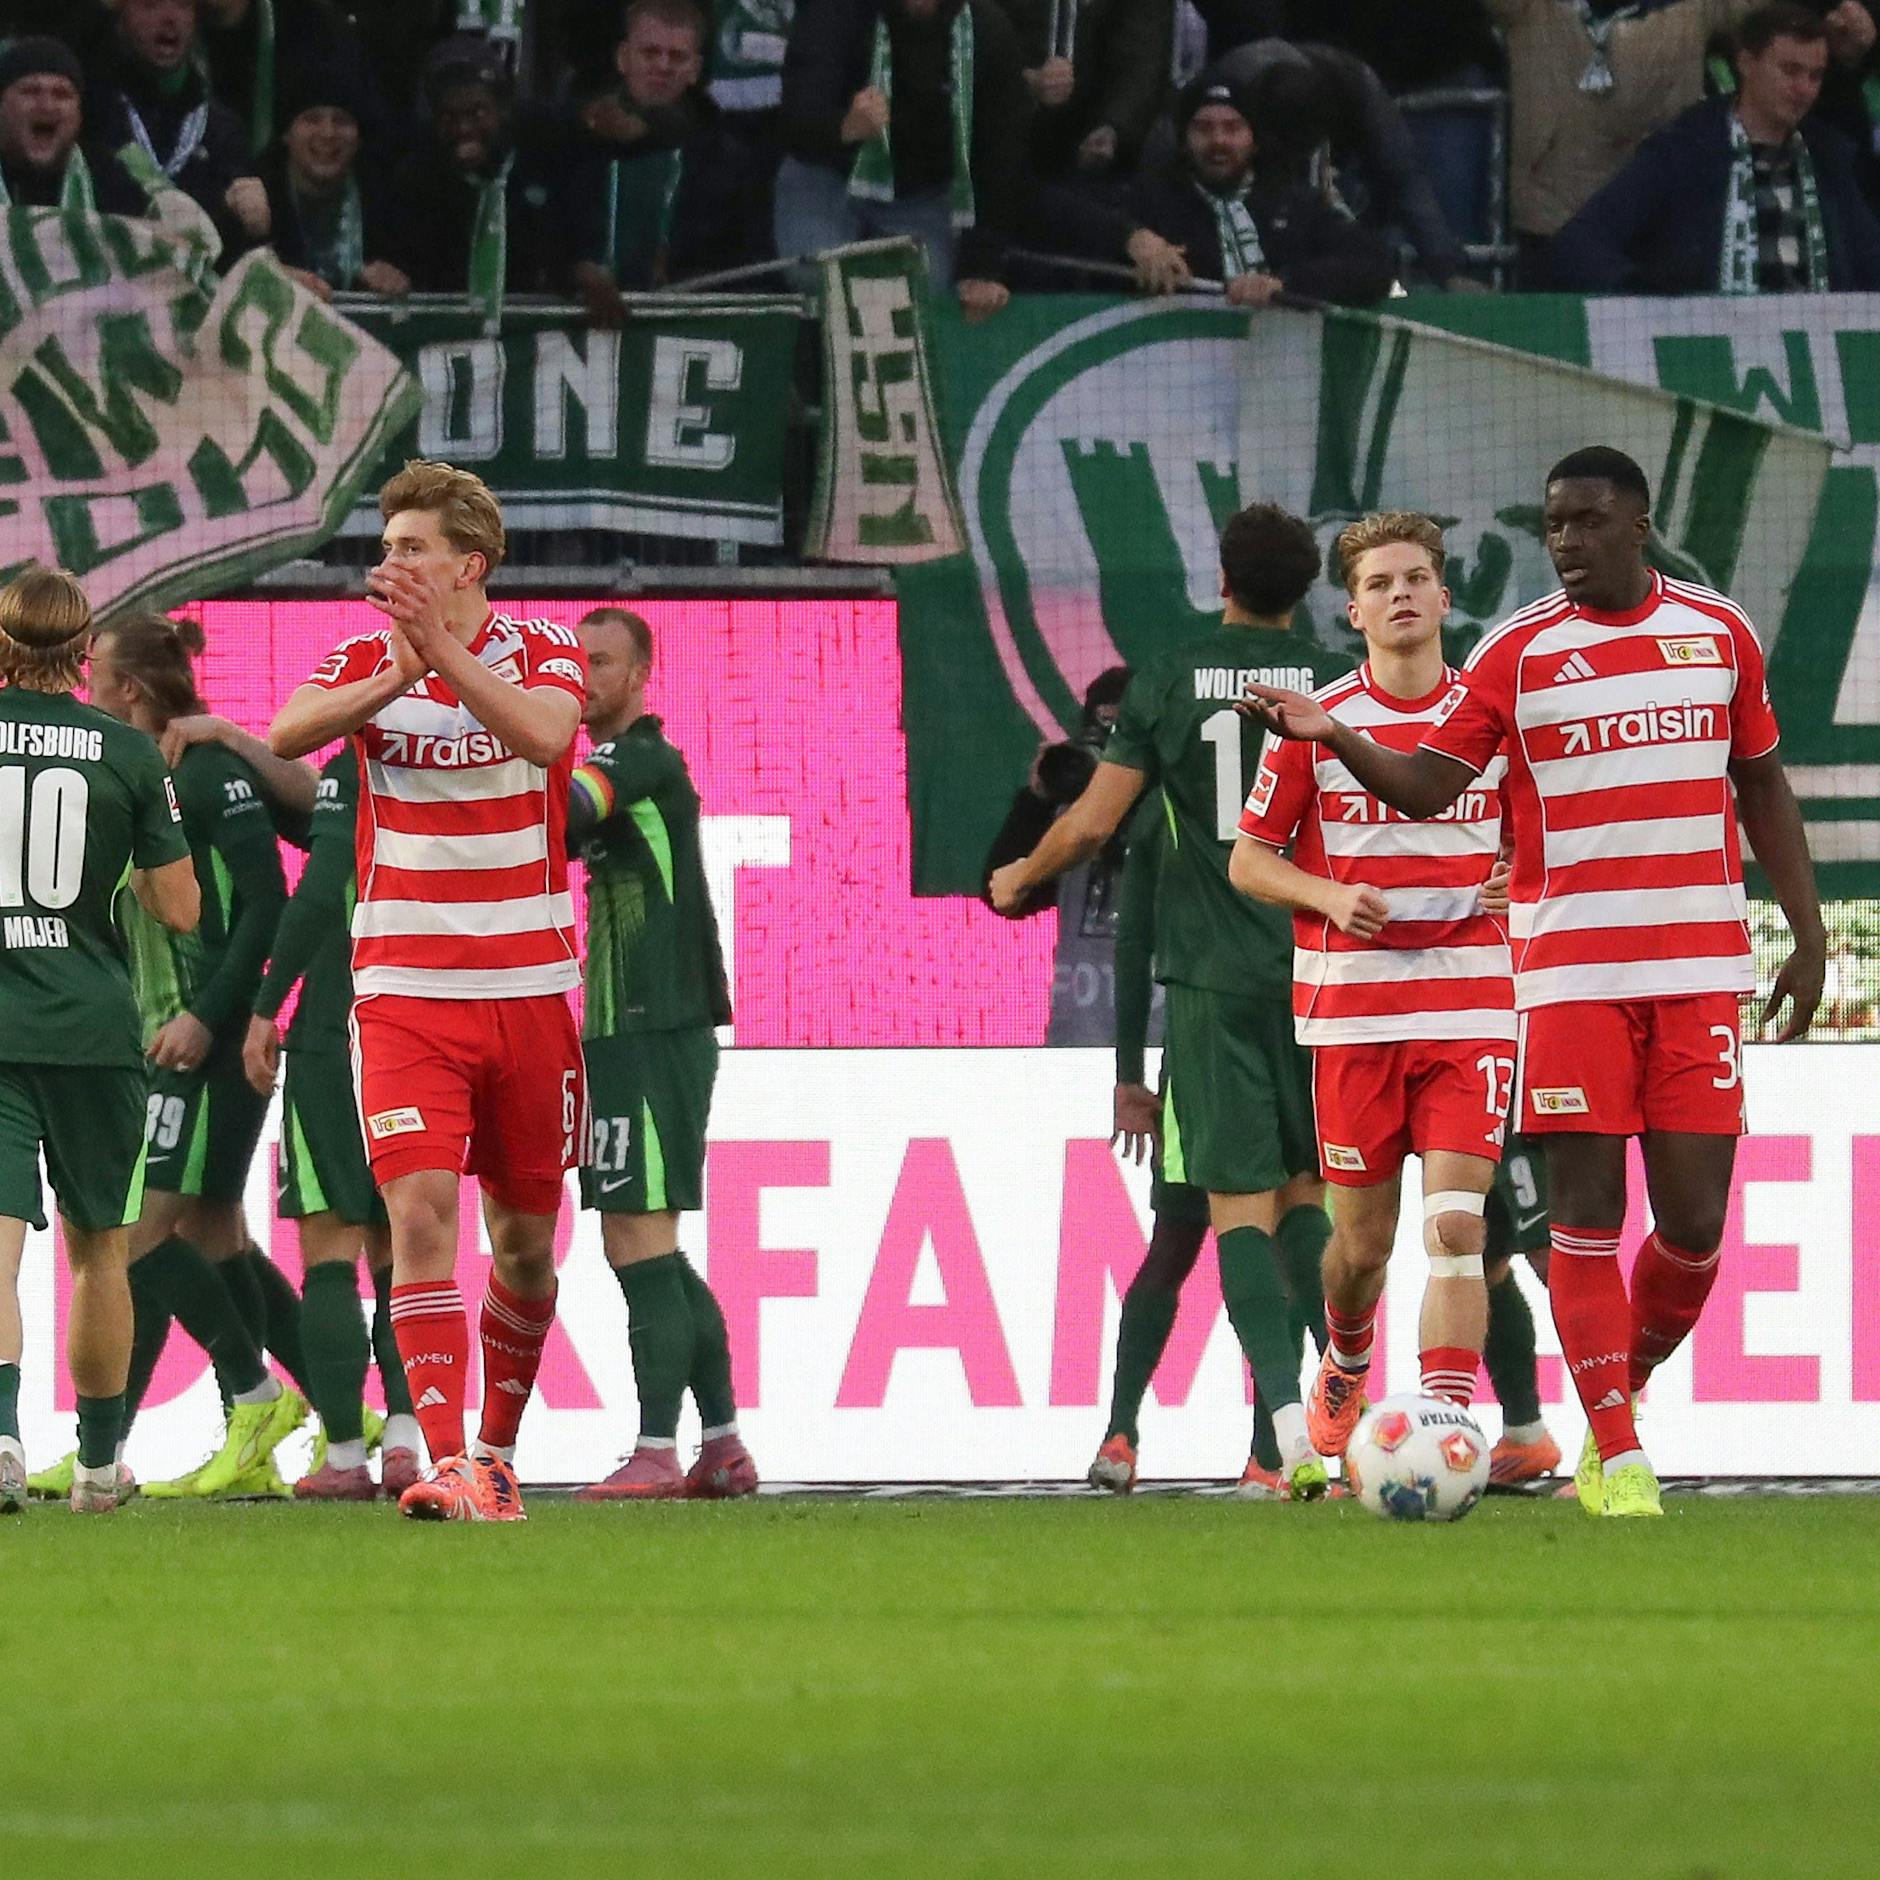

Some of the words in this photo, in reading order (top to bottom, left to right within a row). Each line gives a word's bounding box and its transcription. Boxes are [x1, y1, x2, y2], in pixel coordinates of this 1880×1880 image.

[415, 727, 513, 767] raisi
[1597, 698, 1715, 748] raisin
[0, 765, 90, 910] 10
[3, 915, 70, 950] MAJER
[561, 1069, 577, 1135] 6
[1475, 1054, 1515, 1119] 13
[594, 1116, 632, 1172] 27
